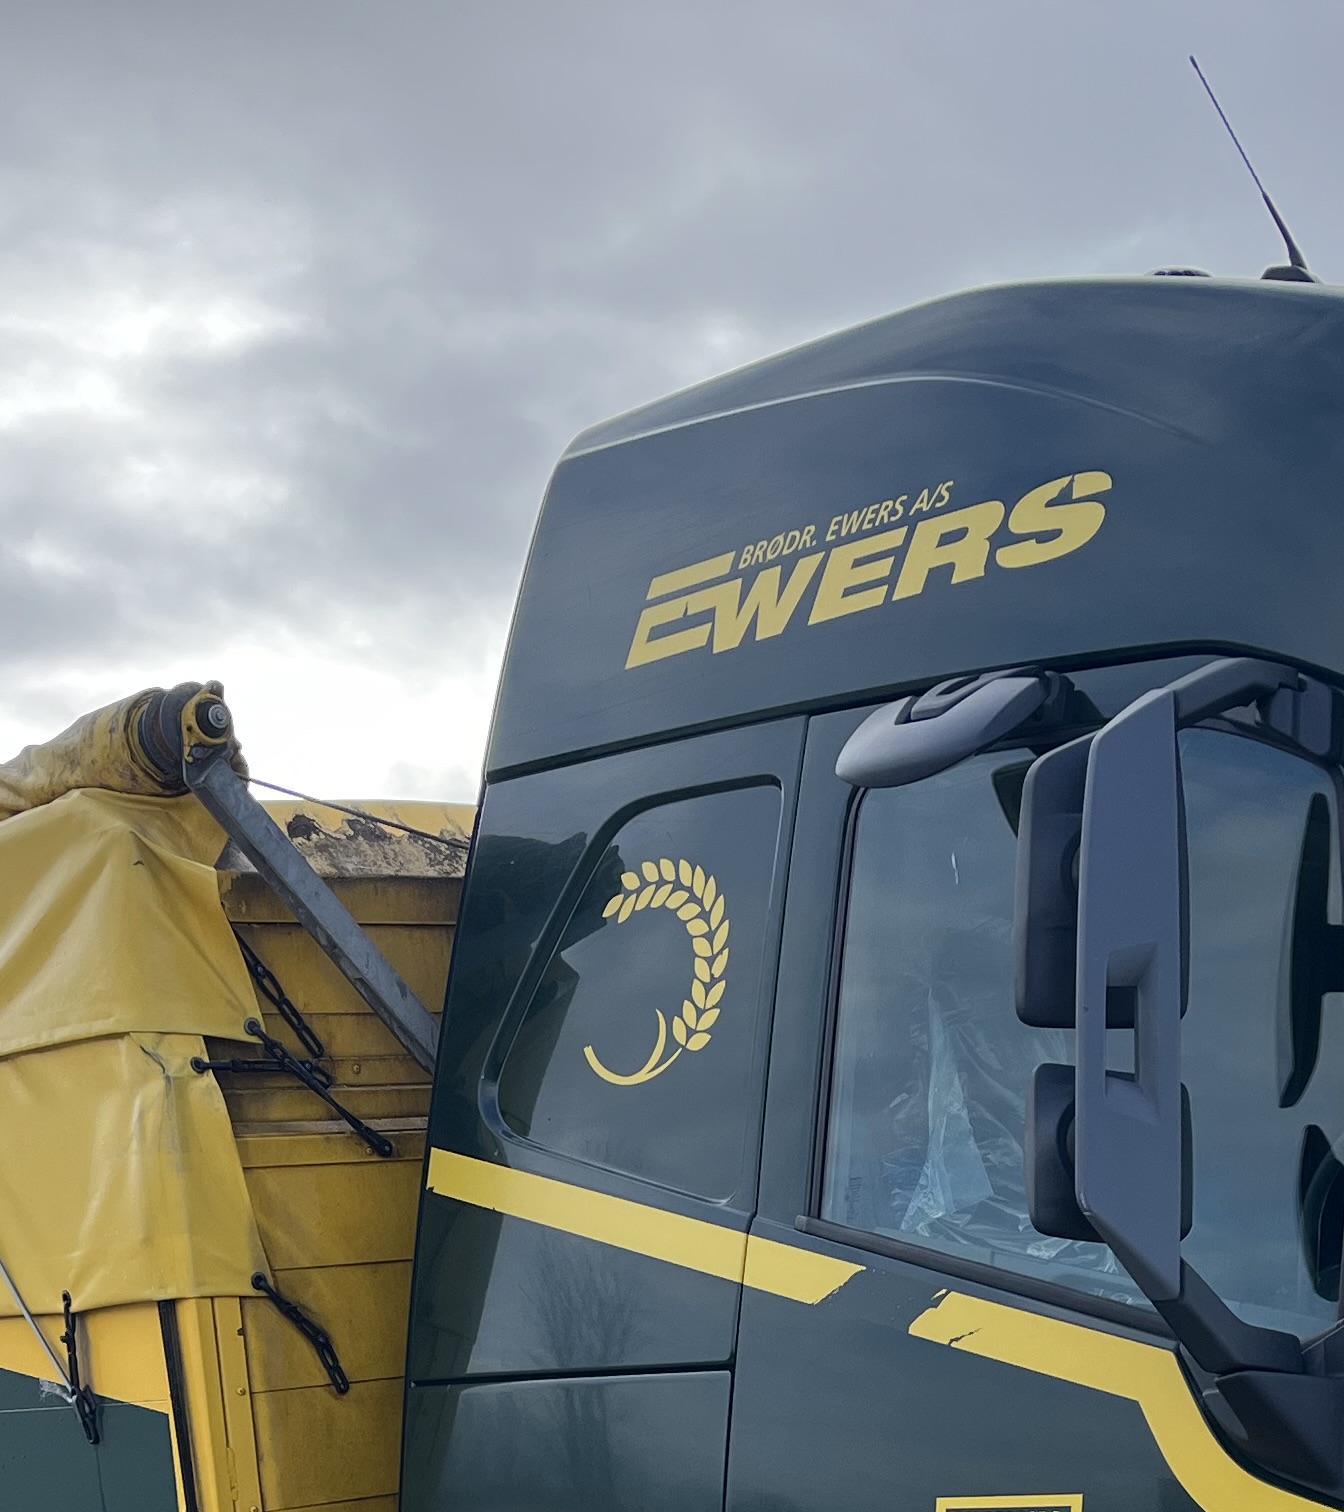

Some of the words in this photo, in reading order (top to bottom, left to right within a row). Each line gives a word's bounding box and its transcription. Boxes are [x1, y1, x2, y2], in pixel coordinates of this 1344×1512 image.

[624, 471, 1112, 670] EWERS
[739, 525, 816, 569] BRØDR.
[825, 494, 908, 541] EWERS
[910, 480, 954, 515] A/S
